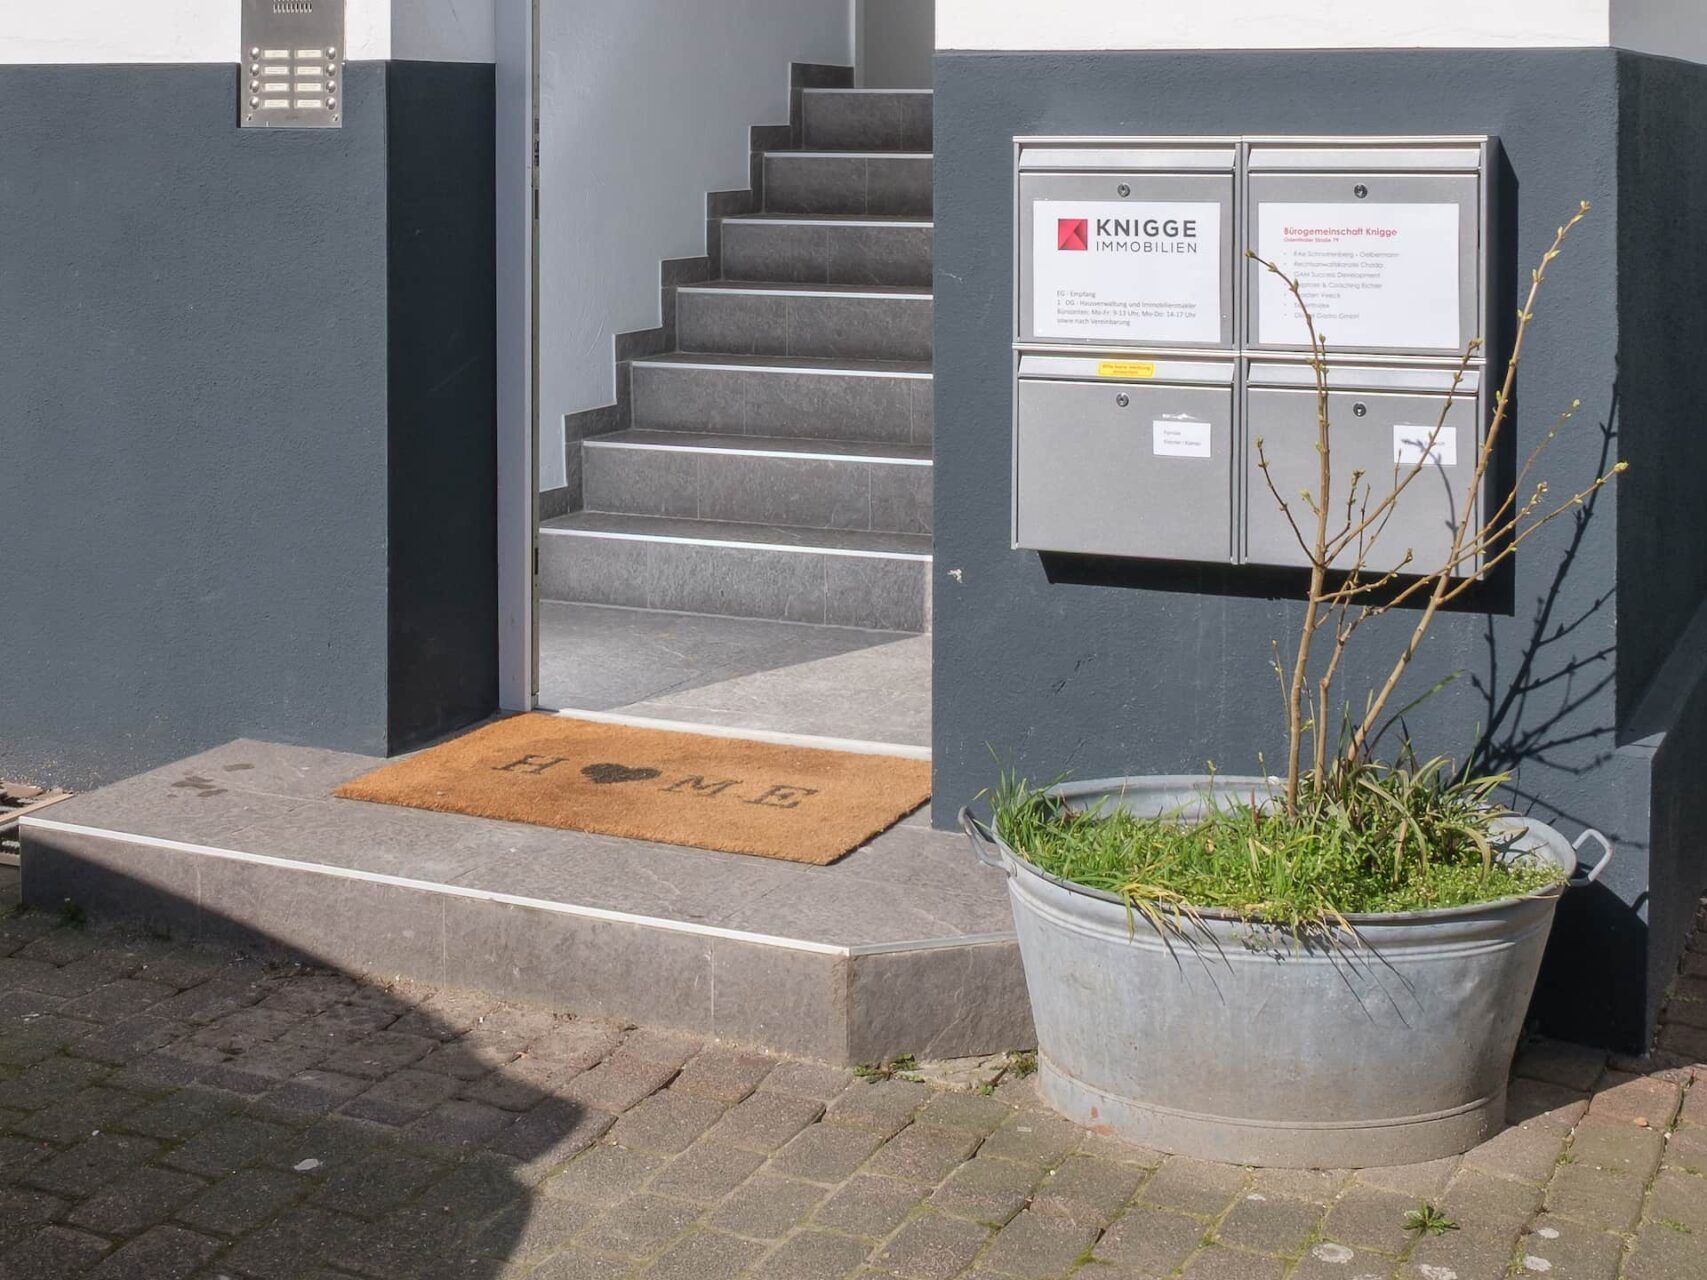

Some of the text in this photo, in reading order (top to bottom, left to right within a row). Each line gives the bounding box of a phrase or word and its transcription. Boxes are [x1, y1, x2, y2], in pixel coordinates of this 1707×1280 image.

[1096, 219, 1197, 238] KNIGGE
[1283, 227, 1398, 237] Bürogemeinschaft Knigge
[1096, 241, 1197, 253] IMMOBILIEN
[491, 753, 820, 811] HME
